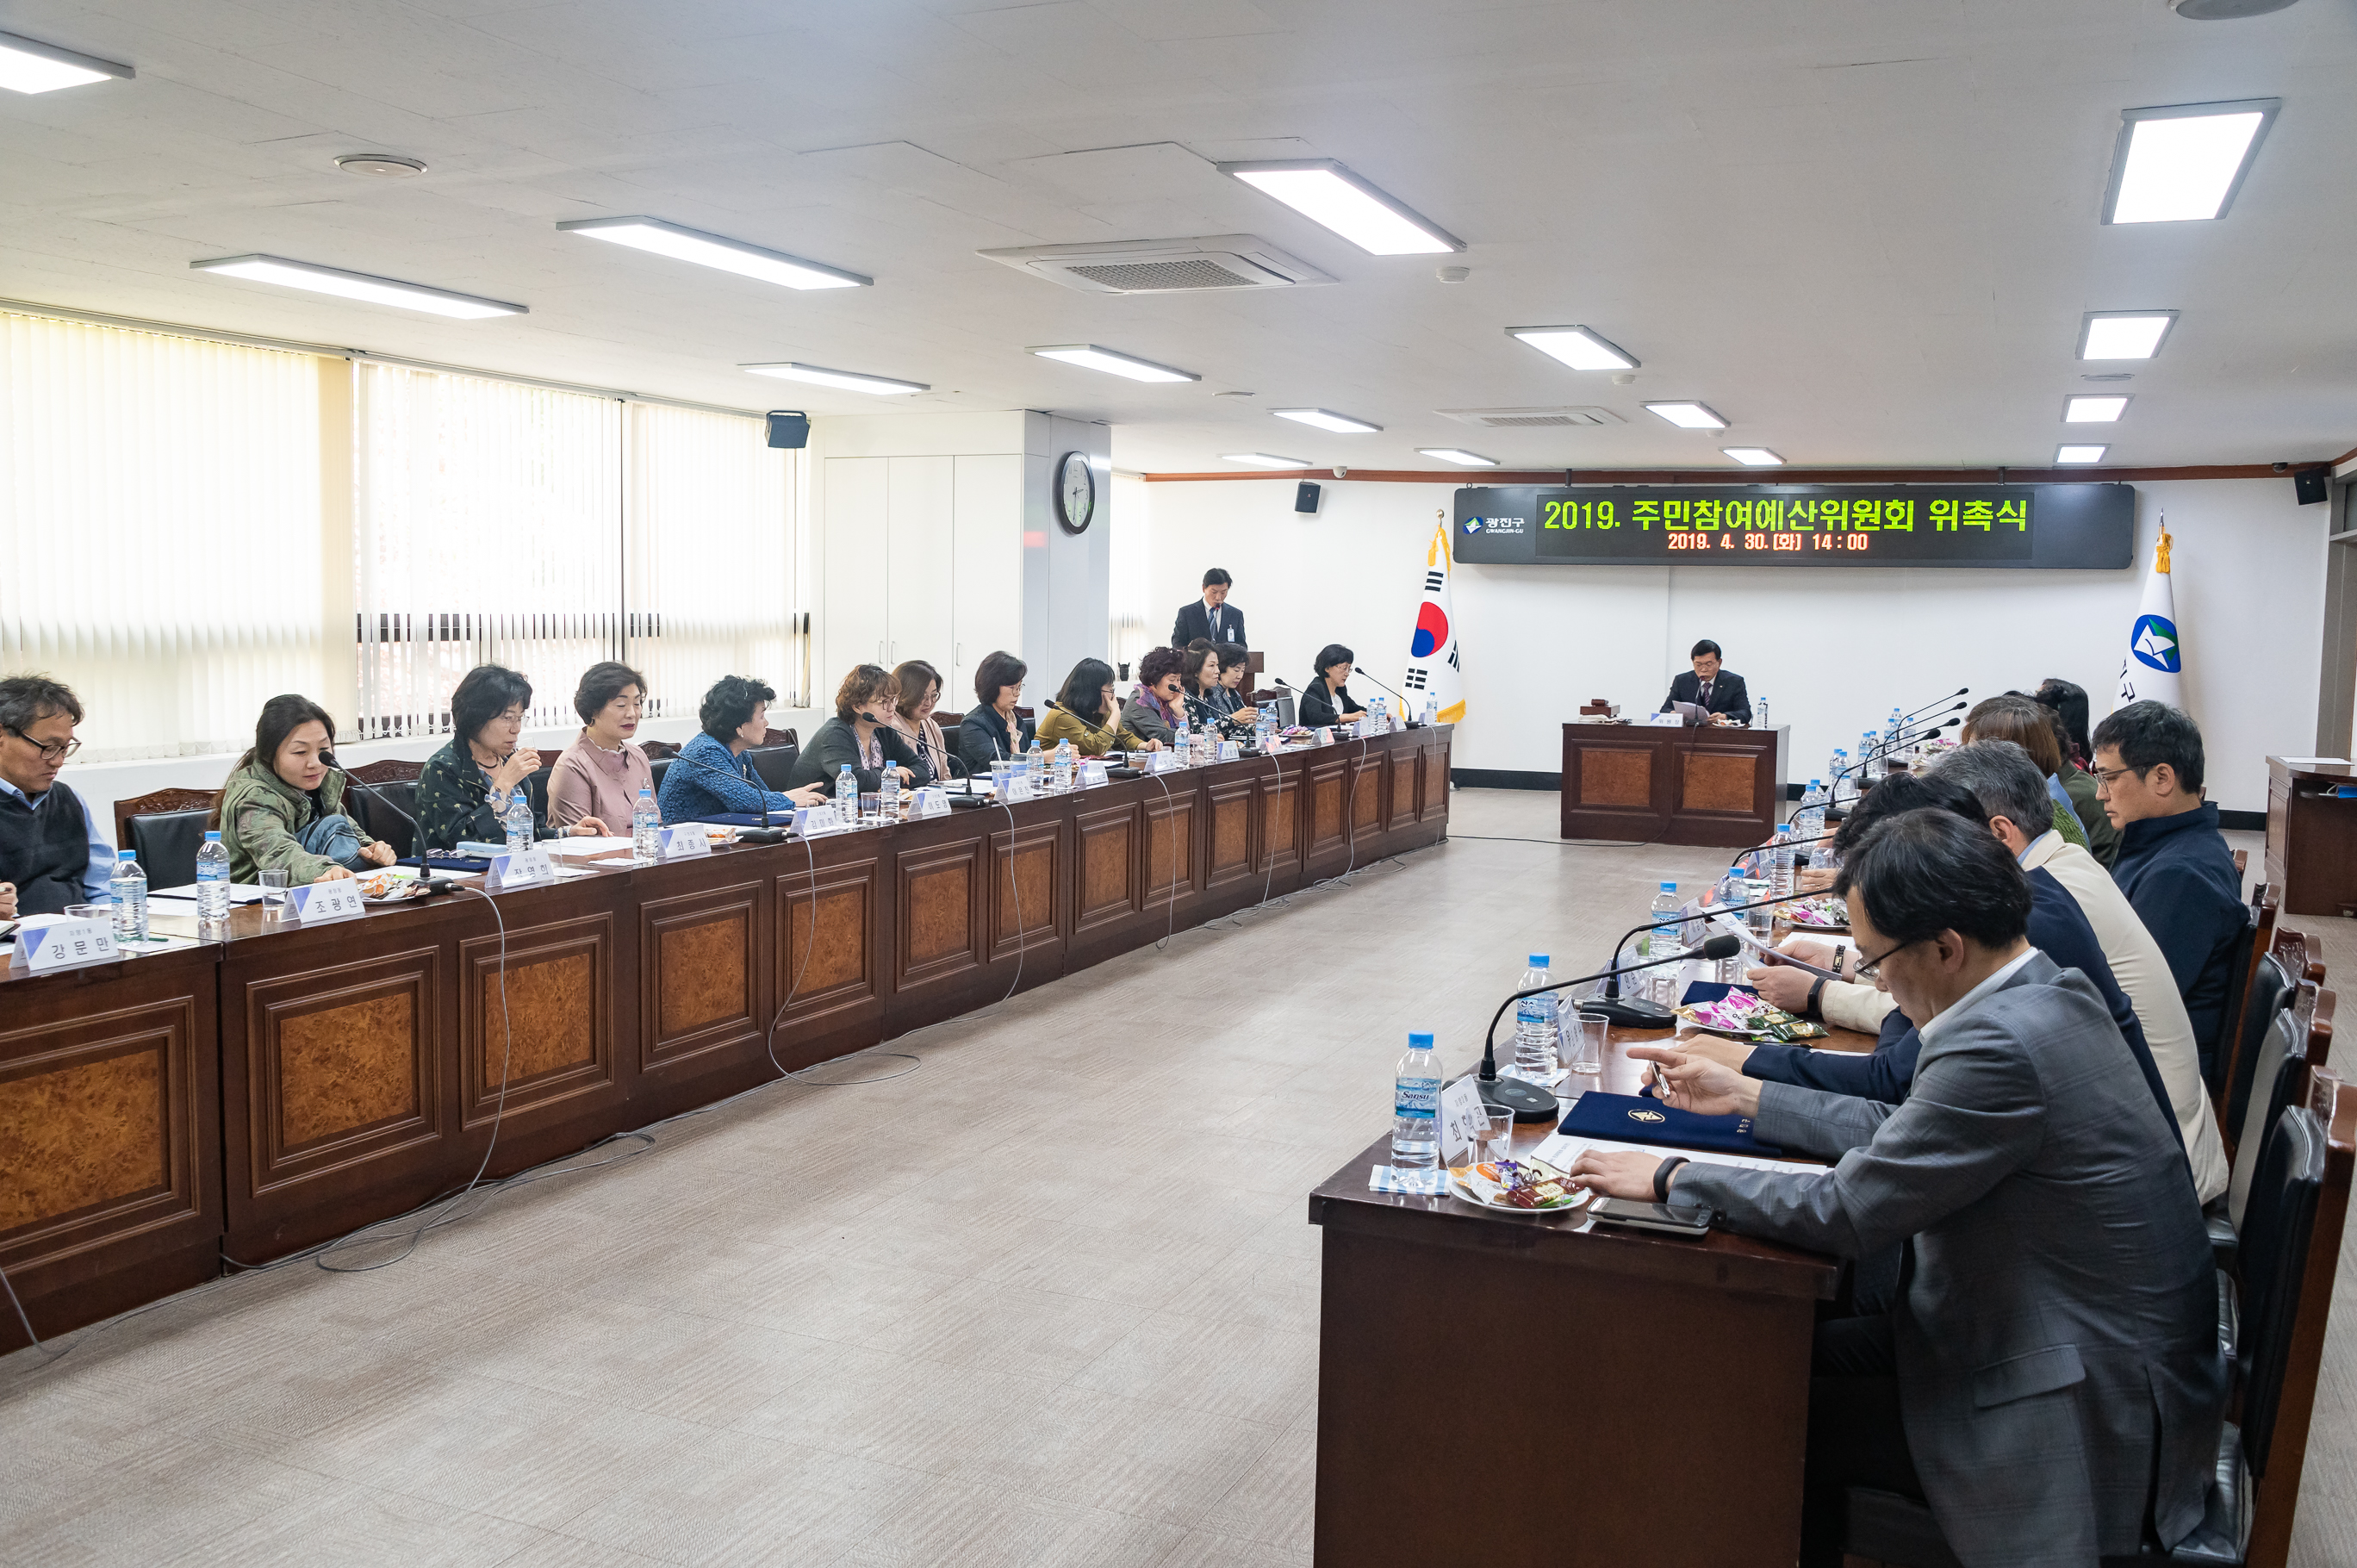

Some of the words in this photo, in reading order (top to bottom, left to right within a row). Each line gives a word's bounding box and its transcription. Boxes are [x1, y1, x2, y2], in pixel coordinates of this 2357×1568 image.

[1485, 518, 1525, 527] 광진구
[1544, 501, 1620, 530] 2019.
[1632, 500, 1913, 532] 주민참여예산위원회
[1929, 500, 2027, 532] 위촉식
[1668, 533, 1711, 550] 2019.
[1720, 533, 1734, 550] 4.
[315, 895, 358, 913] 조광연
[52, 937, 109, 959] 강문만
[1402, 1091, 1430, 1100] Sansu
